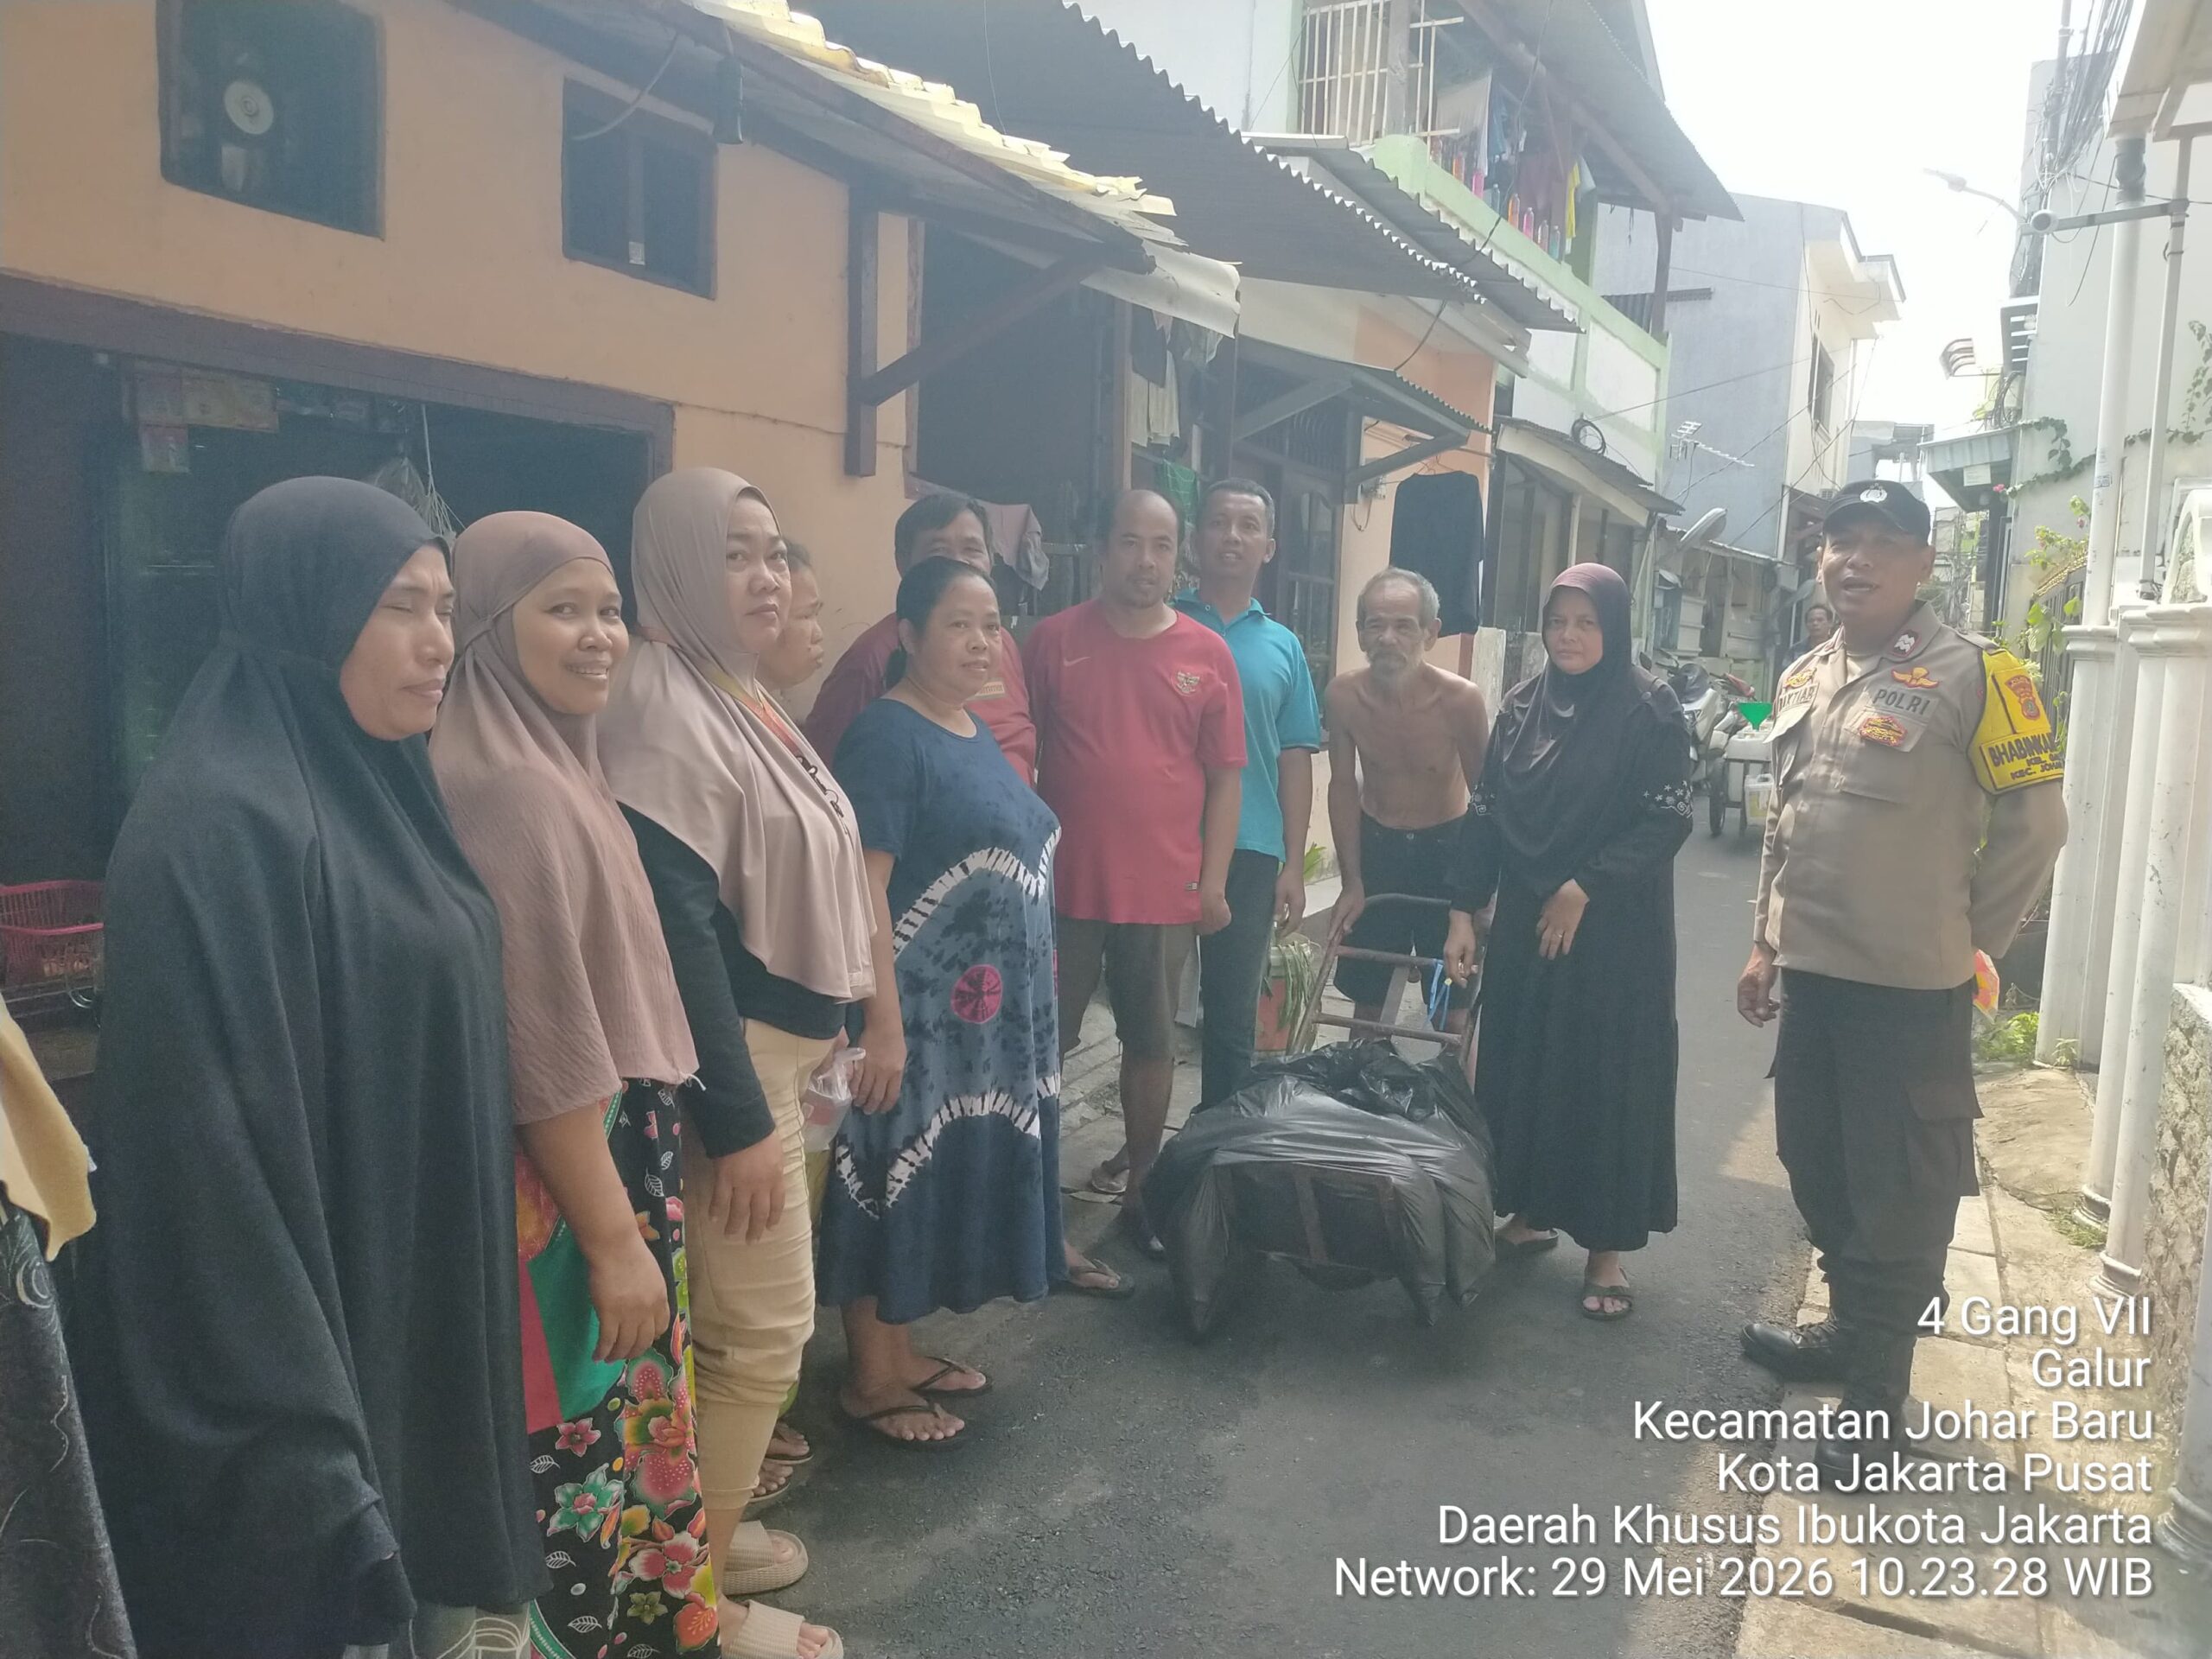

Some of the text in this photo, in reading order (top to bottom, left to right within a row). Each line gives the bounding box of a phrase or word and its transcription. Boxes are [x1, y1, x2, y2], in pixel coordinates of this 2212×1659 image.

[1872, 689, 1930, 715] POLRI
[2026, 756, 2047, 766] KEL.
[2011, 767, 2037, 780] KEC.
